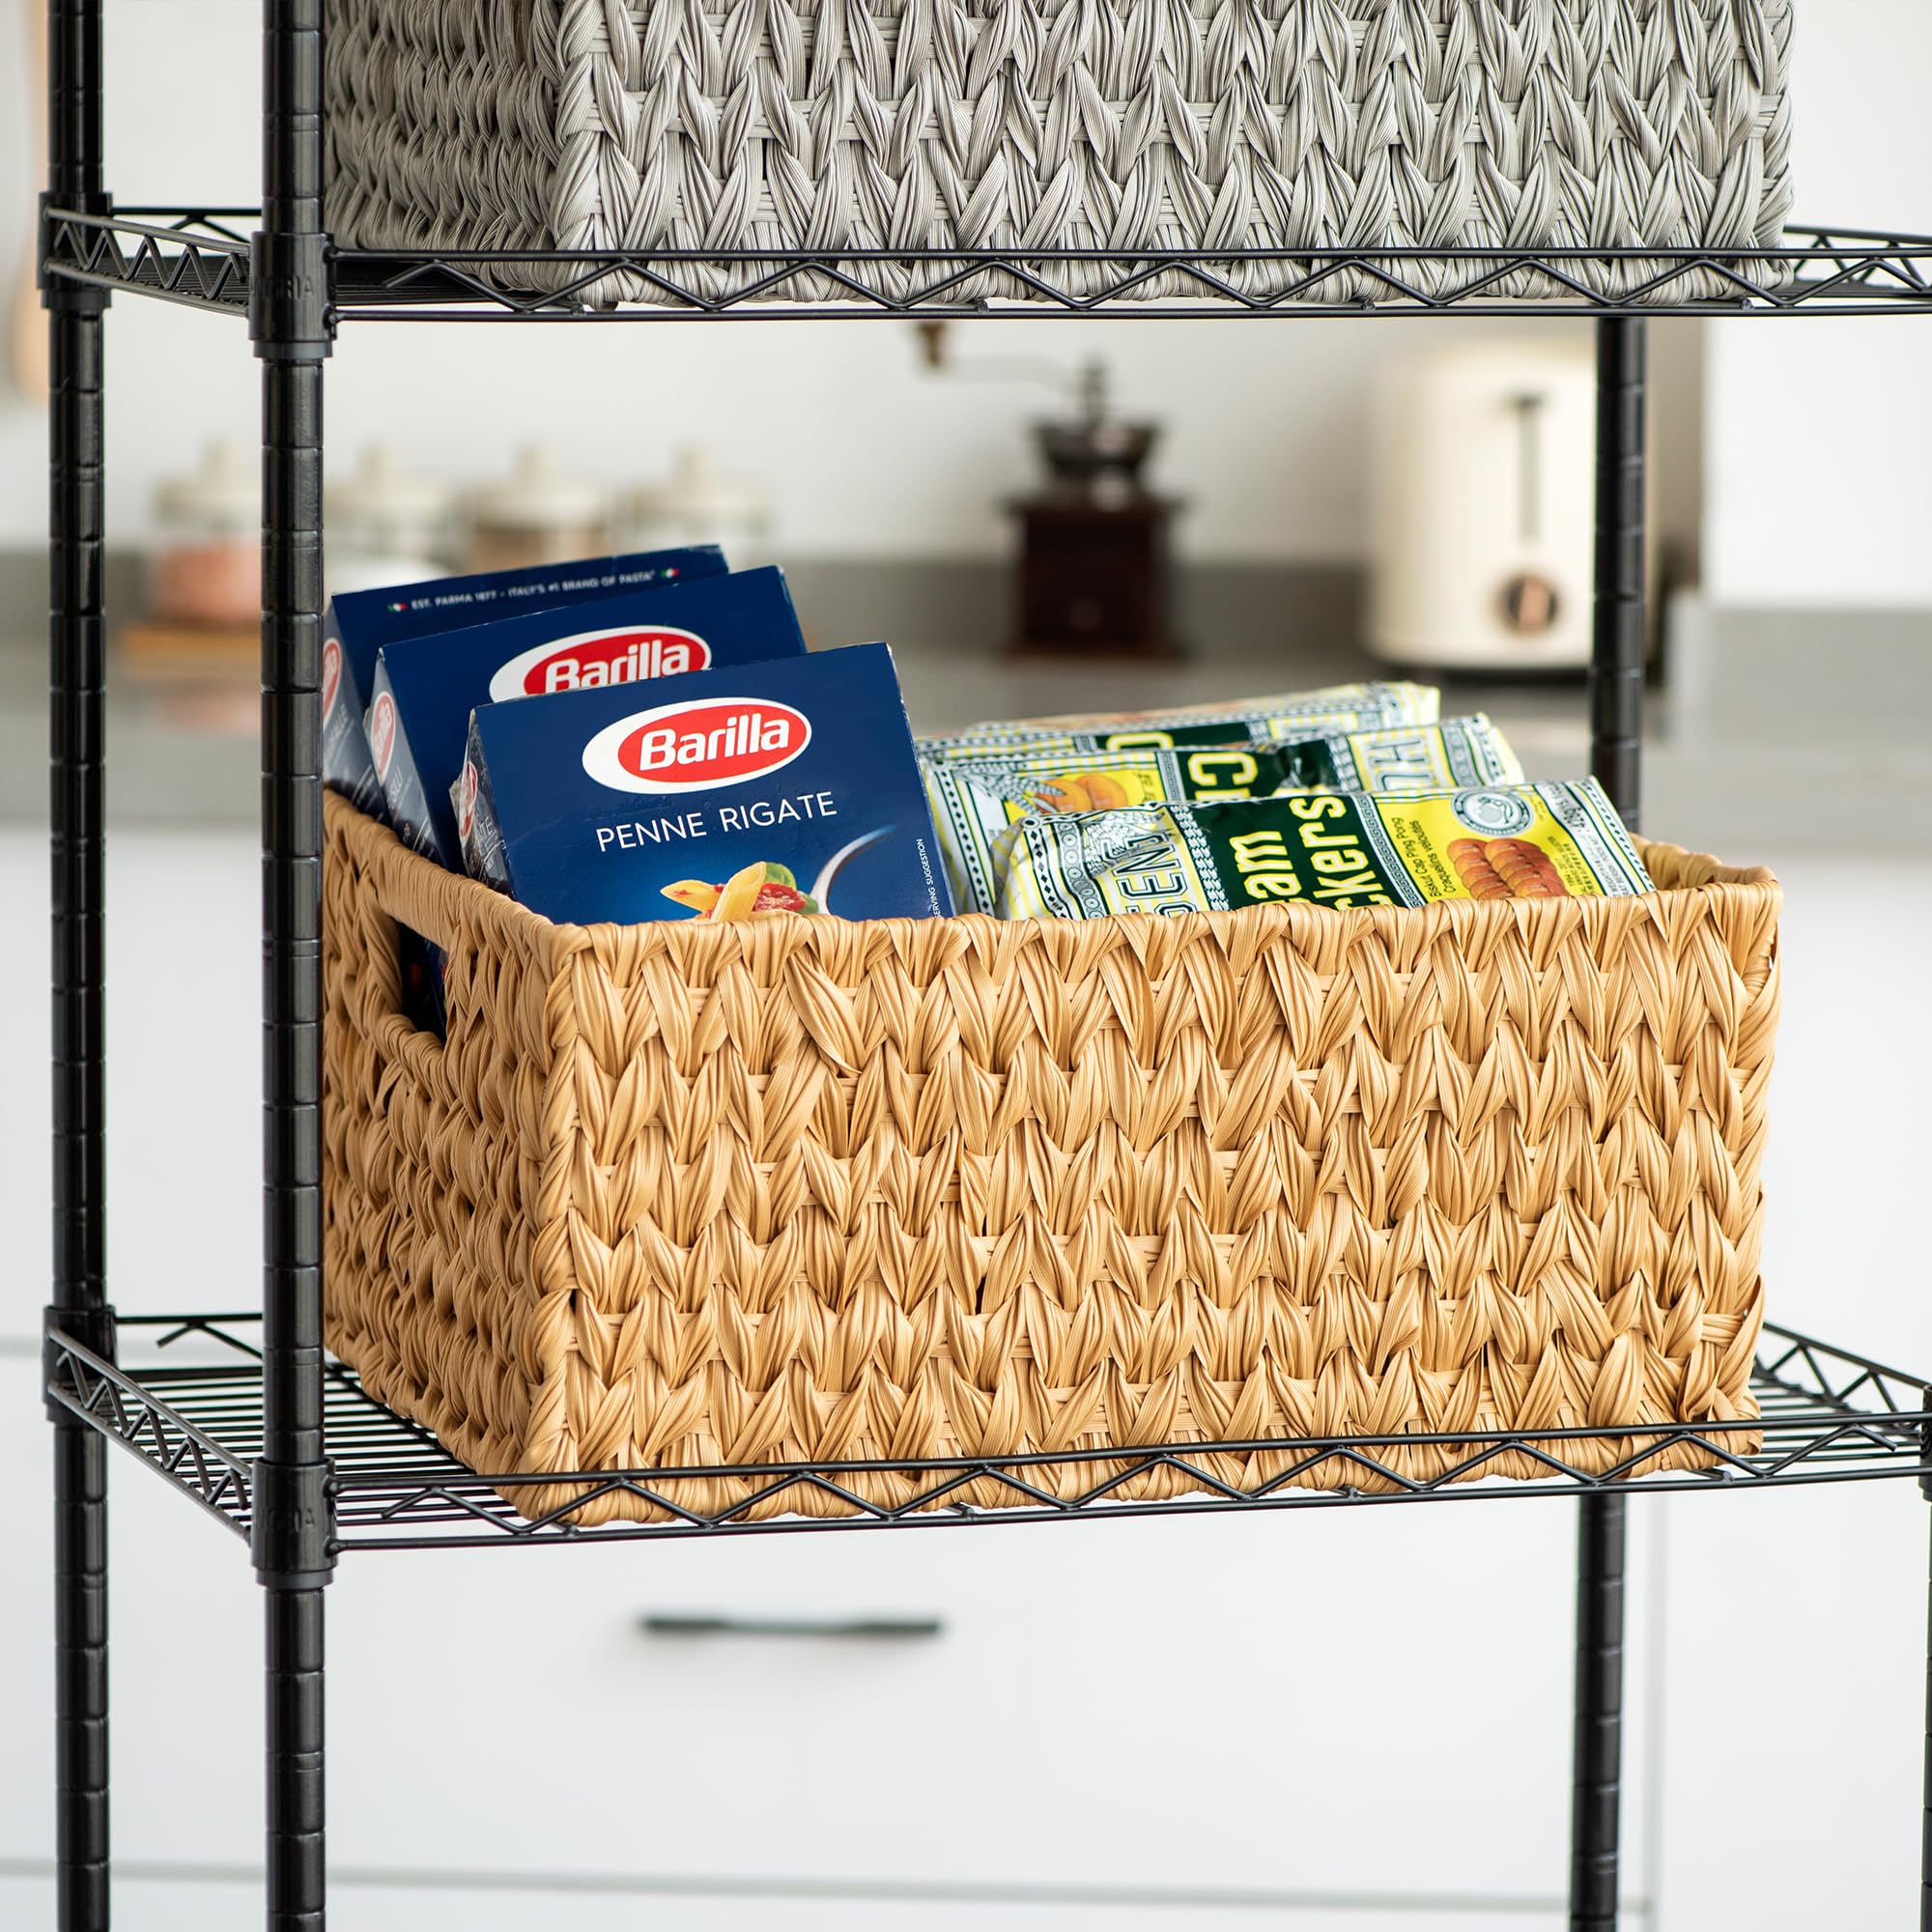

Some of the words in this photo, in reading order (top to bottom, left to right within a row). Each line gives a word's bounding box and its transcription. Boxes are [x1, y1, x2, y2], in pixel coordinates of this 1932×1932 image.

[435, 593, 473, 607] PARMA
[507, 583, 546, 597] ITALY'S
[561, 578, 599, 592] BRAND
[601, 576, 616, 587] OF
[544, 639, 691, 694] Barilla
[639, 713, 790, 772] Barilla
[596, 812, 707, 852] PENNE
[719, 791, 838, 832] RIGATE
[1391, 817, 1408, 839] Pong
[916, 838, 934, 886] SUGGESTION
[1403, 839, 1419, 859] Ping
[1412, 858, 1428, 874] Cap
